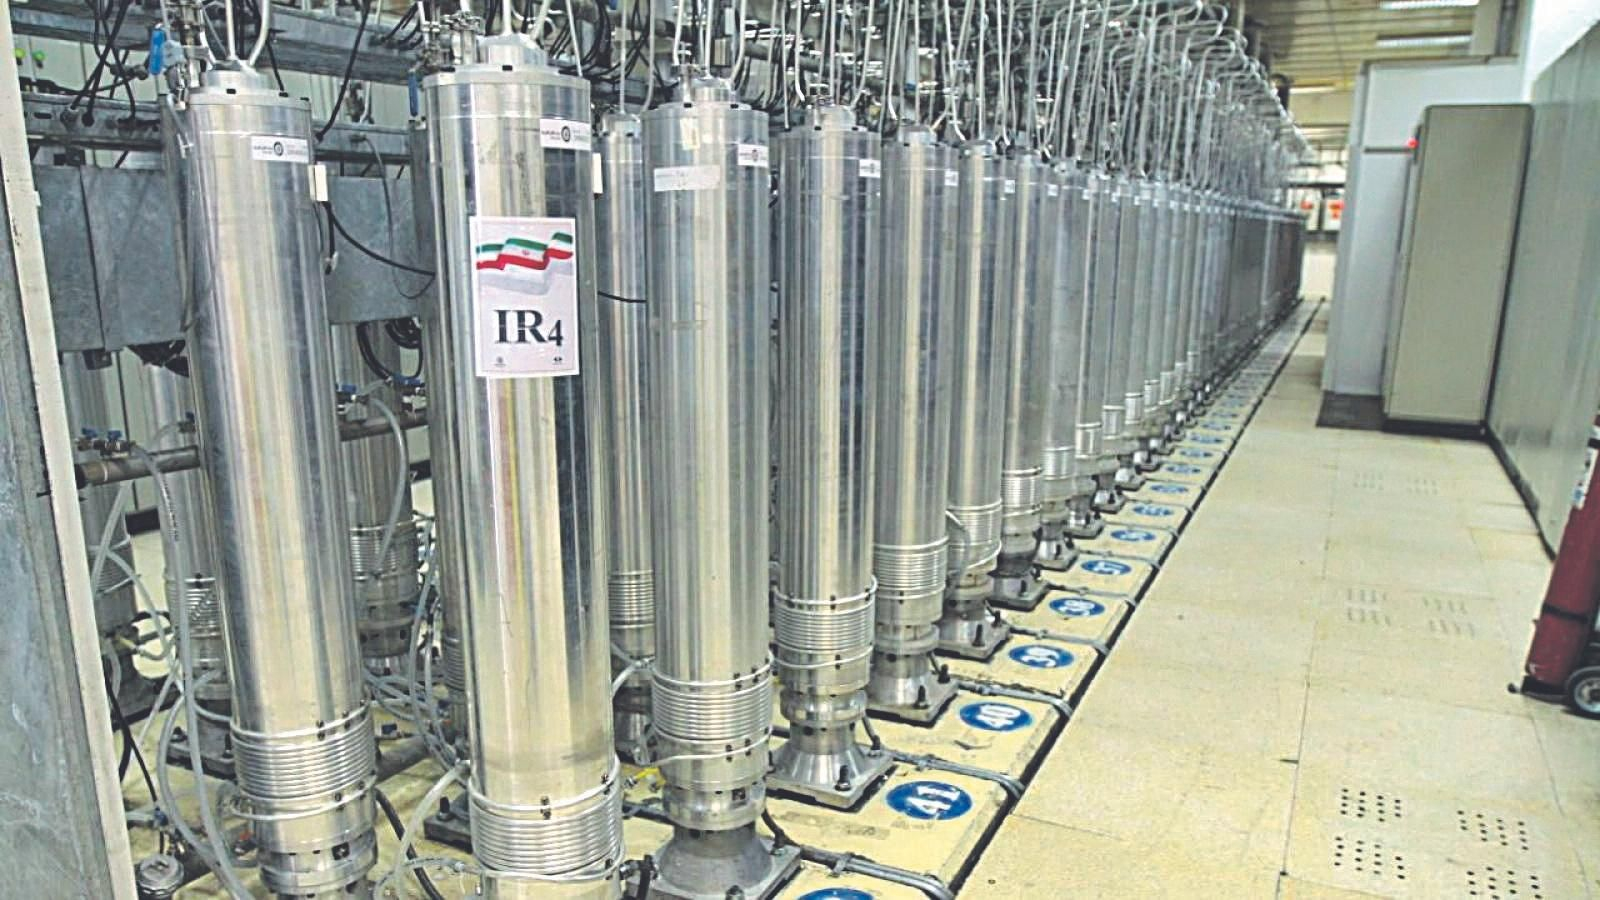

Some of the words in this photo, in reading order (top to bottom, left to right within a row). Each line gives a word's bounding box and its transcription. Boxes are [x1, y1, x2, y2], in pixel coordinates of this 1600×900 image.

[493, 309, 563, 346] IR4
[1058, 599, 1095, 616] 38
[1021, 646, 1060, 668] 39
[976, 704, 1021, 728] 40
[906, 785, 960, 815] 41
